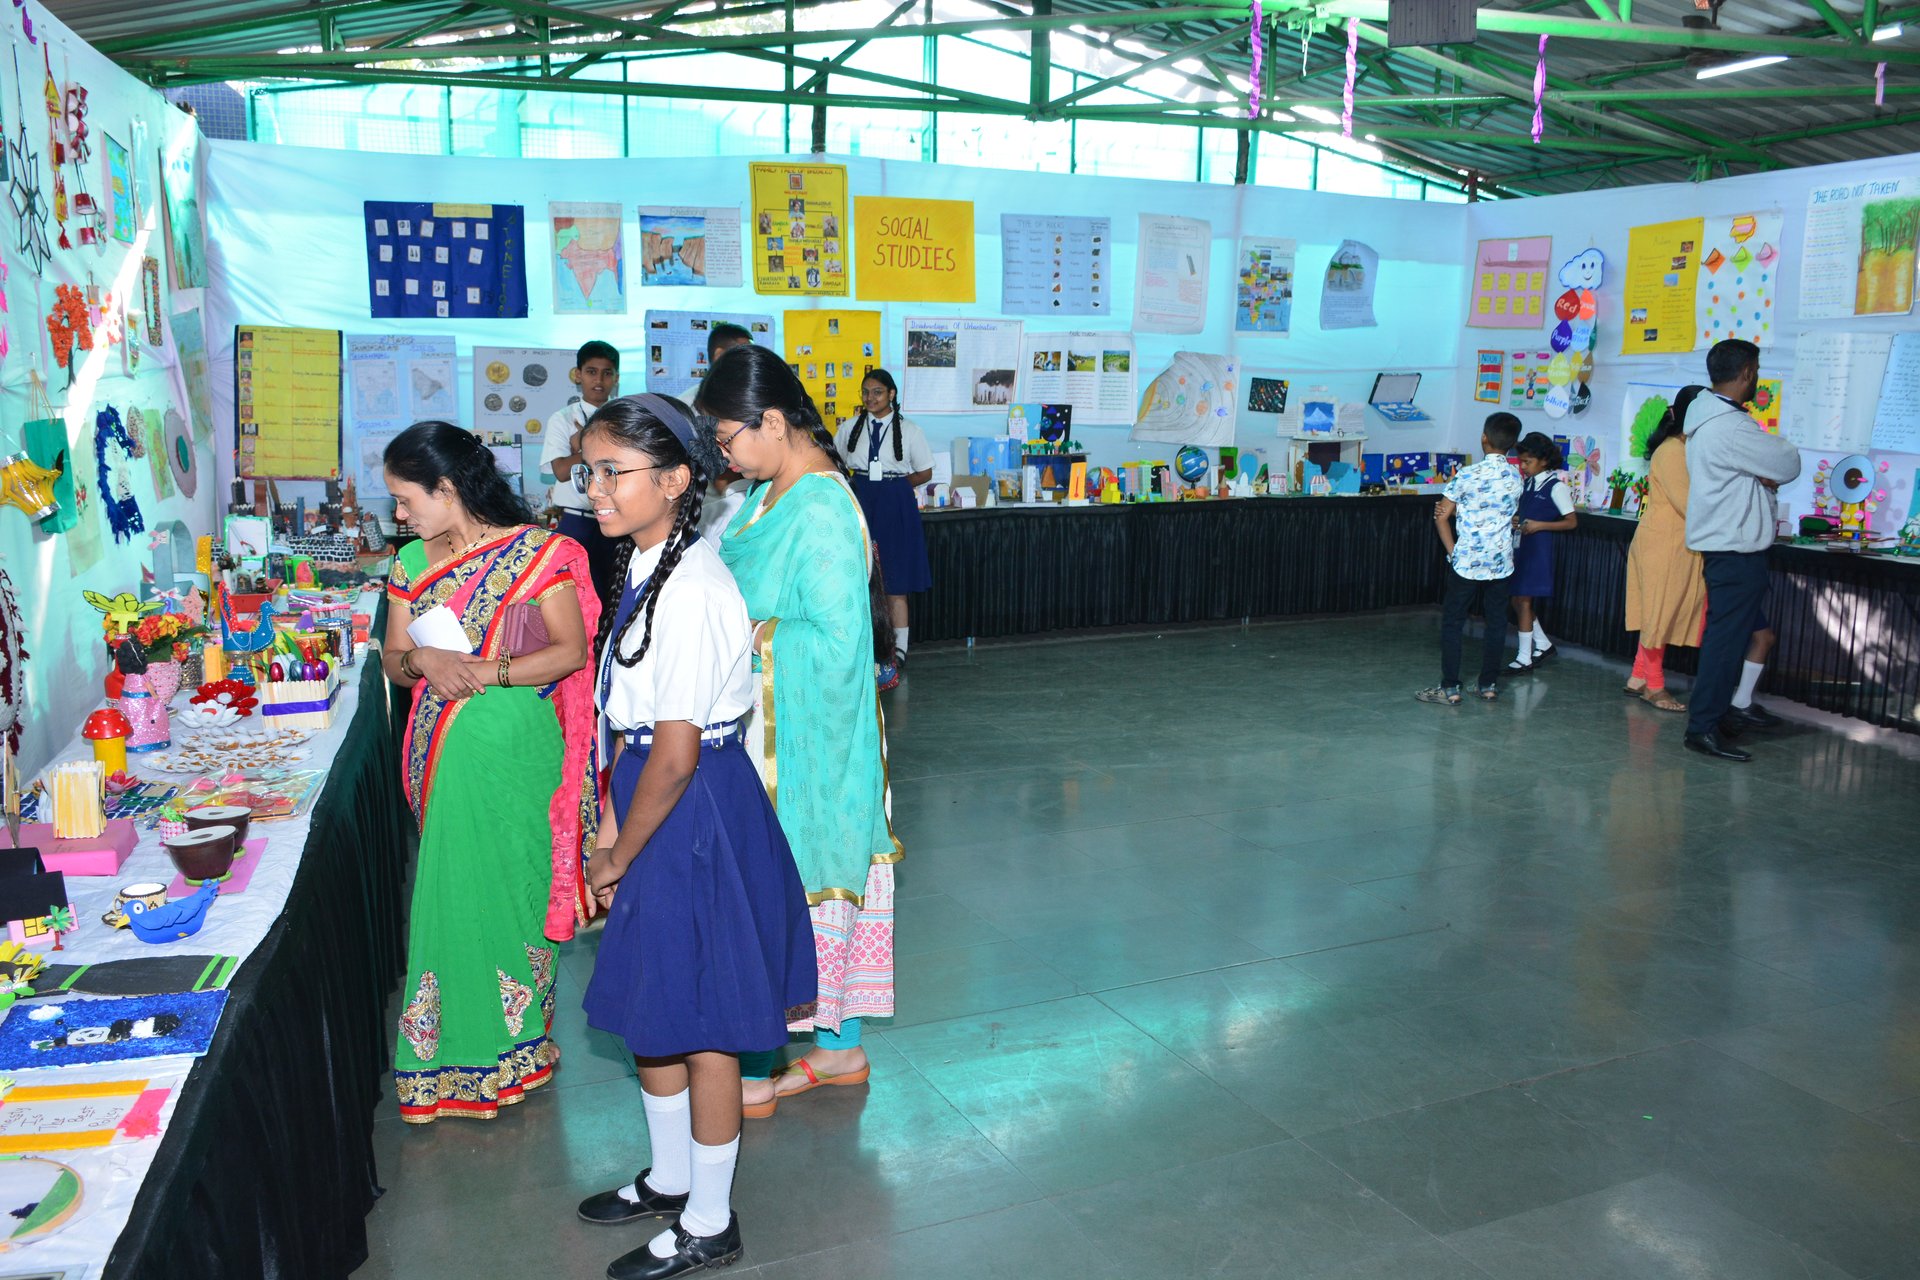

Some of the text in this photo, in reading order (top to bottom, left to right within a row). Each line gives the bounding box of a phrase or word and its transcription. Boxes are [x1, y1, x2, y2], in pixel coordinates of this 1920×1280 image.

[1813, 180, 1900, 204] THE ROAD NOT TAKEN
[876, 216, 933, 241] SOCIAL
[872, 243, 956, 272] STUDIES
[1556, 298, 1578, 314] Red
[1545, 394, 1568, 409] White
